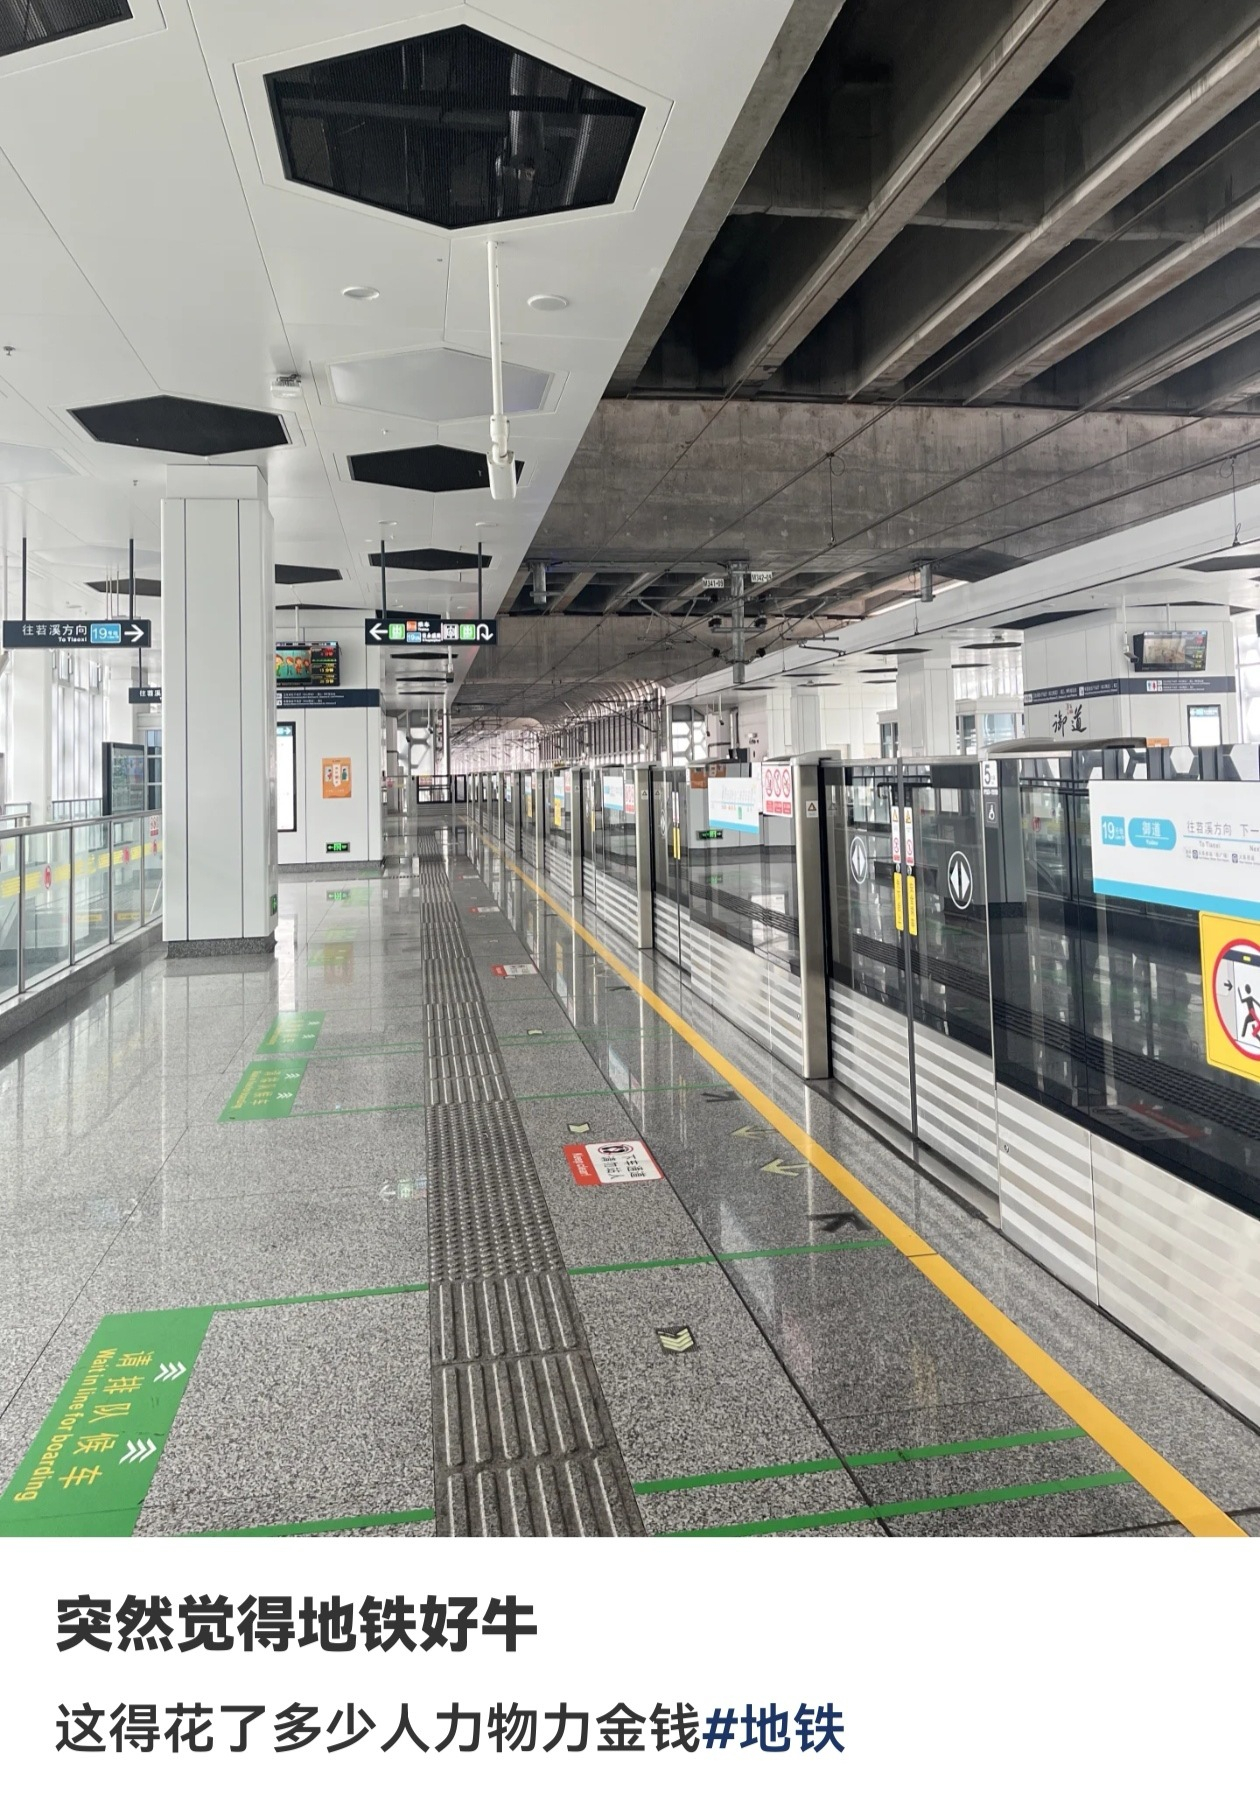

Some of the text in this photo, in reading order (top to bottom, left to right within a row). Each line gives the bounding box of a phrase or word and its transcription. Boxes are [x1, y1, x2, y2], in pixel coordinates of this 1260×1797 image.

[22, 624, 87, 636] 往苕溪方向
[1187, 820, 1232, 836] 往苕溪方向
[13, 1348, 118, 1501] Wait in line for boarding
[58, 1350, 155, 1489] 请排队候车
